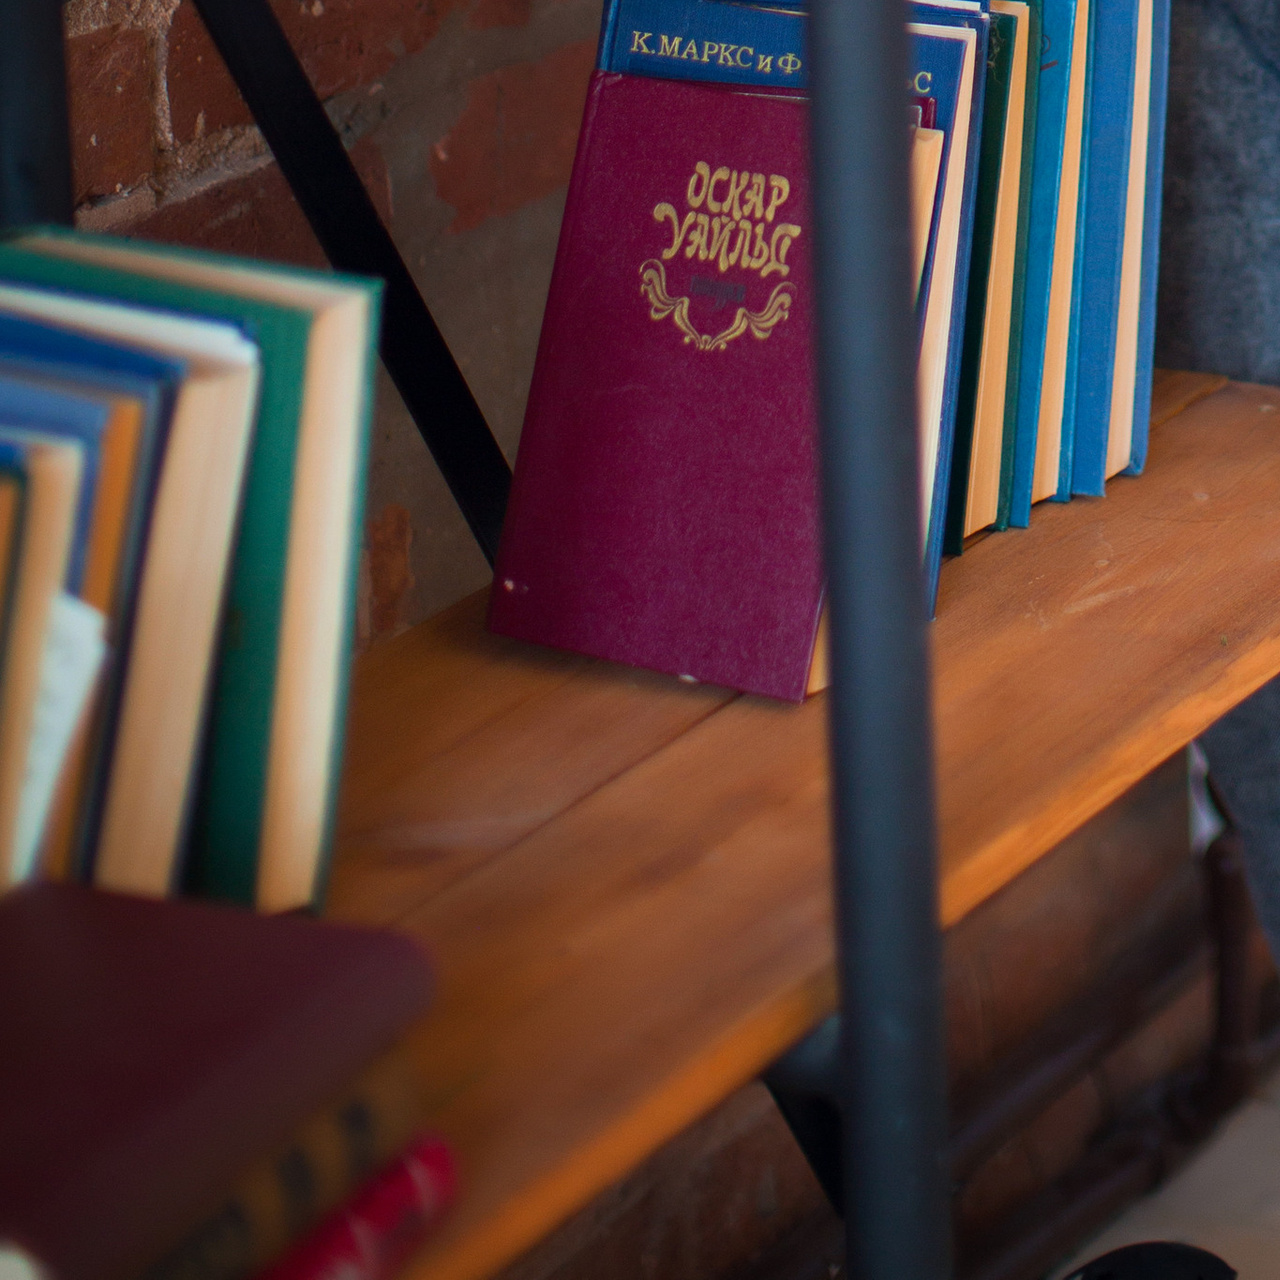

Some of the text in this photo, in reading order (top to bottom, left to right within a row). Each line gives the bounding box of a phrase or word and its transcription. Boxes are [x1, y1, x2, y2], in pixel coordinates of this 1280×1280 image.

[630, 30, 755, 68] К.МАРКС
[757, 53, 773, 74] и
[687, 161, 791, 223] ОСКАР
[653, 202, 802, 278] УАЙЛЬД
